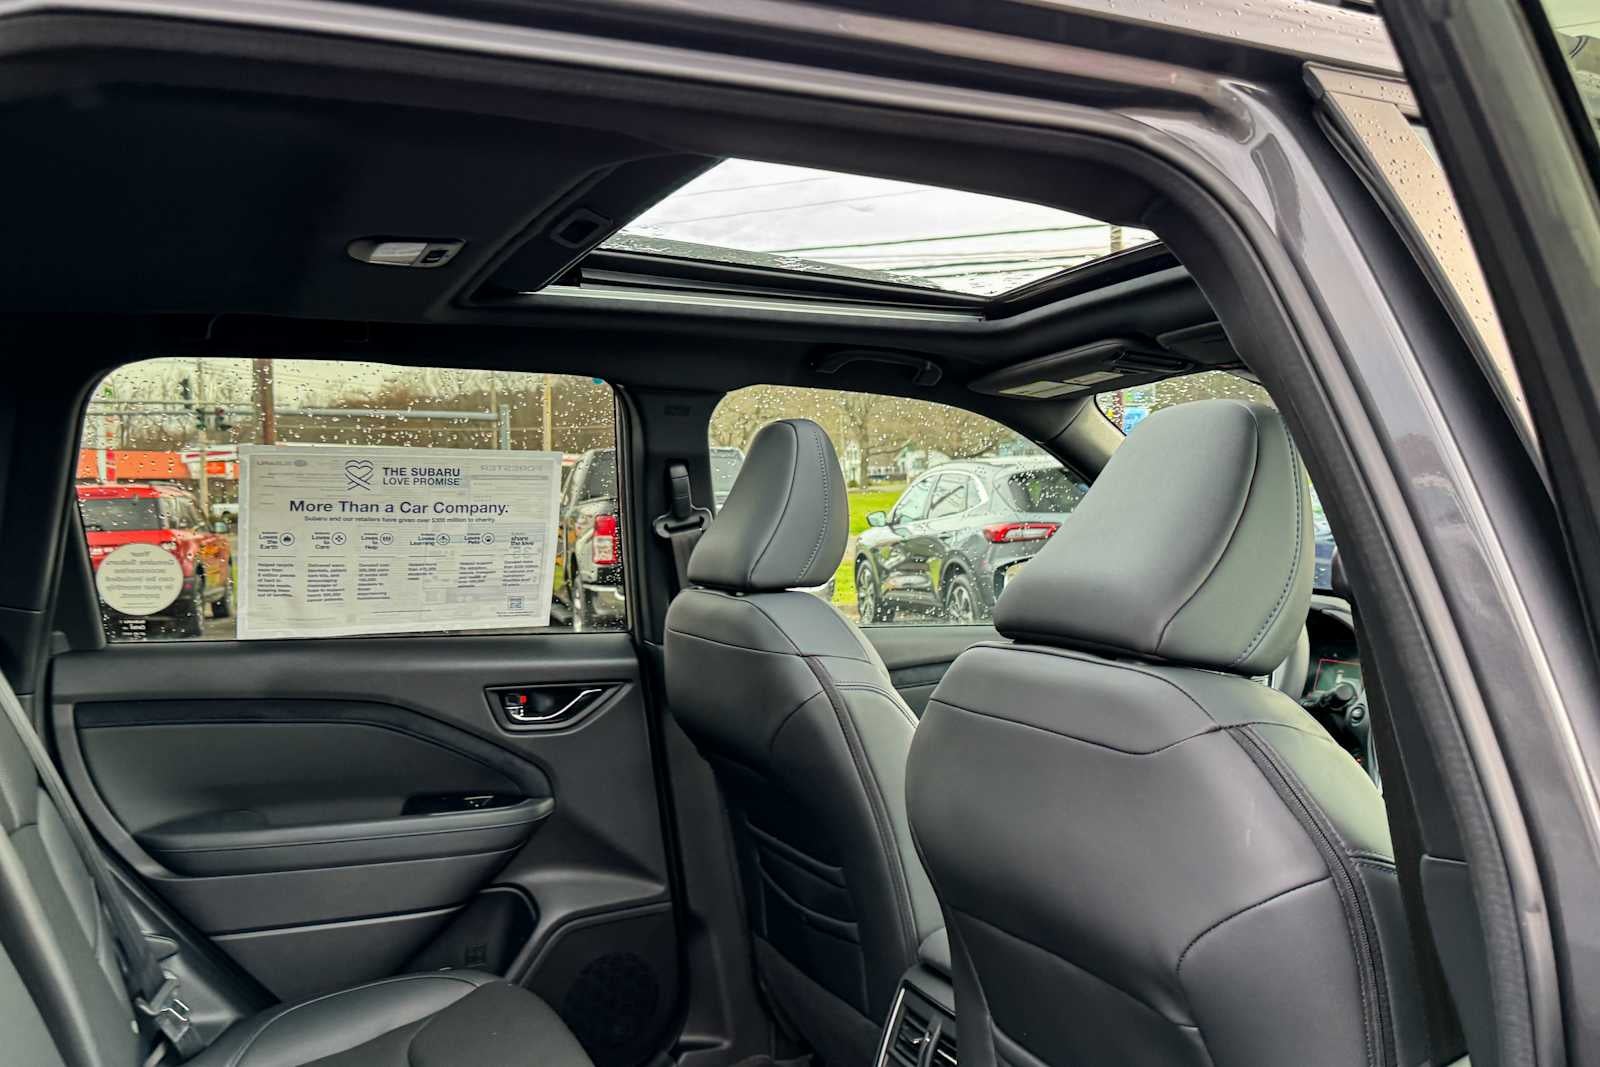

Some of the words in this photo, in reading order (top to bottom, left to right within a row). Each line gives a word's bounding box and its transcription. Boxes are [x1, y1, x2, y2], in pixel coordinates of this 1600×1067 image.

[382, 467, 407, 476] THE
[410, 467, 461, 477] SUBARU
[383, 477, 410, 486] LOVE
[413, 478, 461, 486] PROMISE
[289, 500, 334, 512] More
[338, 500, 380, 513] Than
[385, 503, 394, 513] a
[400, 501, 429, 514] Car
[433, 501, 509, 516] Company.
